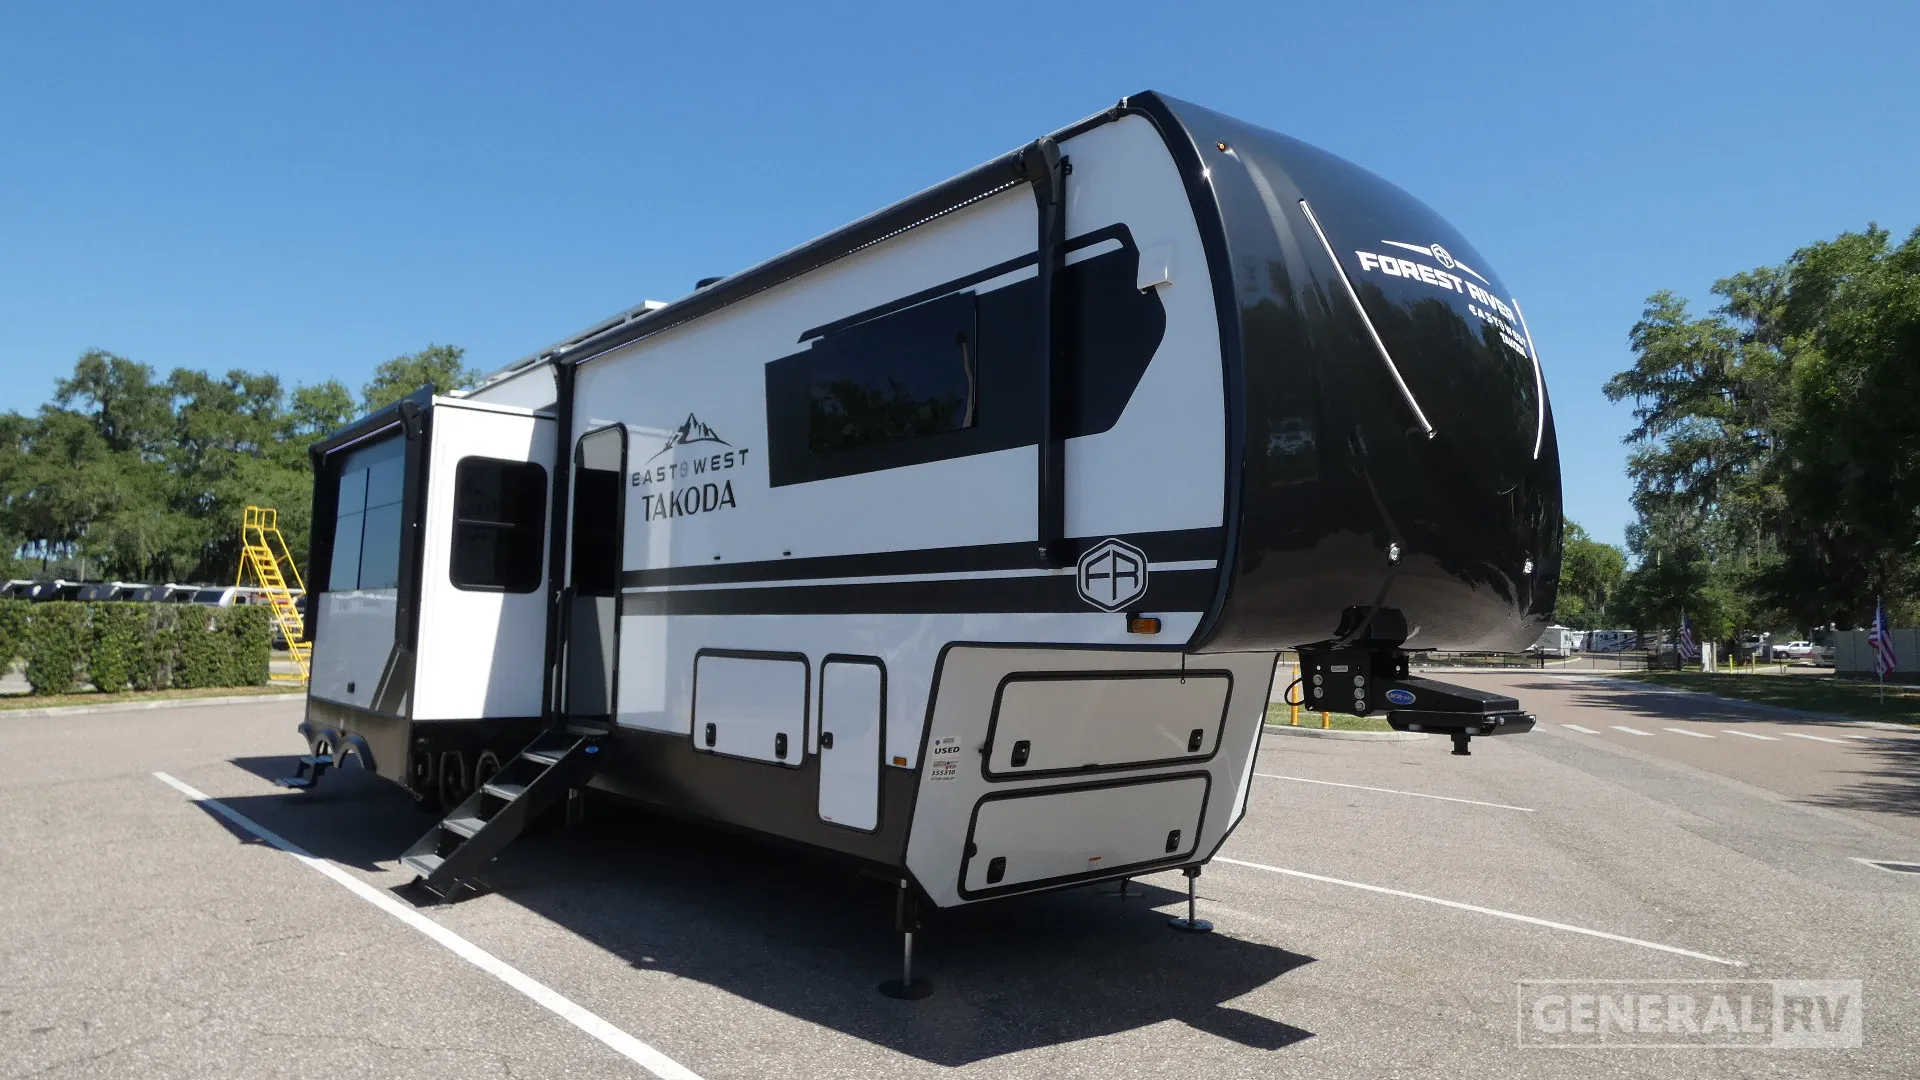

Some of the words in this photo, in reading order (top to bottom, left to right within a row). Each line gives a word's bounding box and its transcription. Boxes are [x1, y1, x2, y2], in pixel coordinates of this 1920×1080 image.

[1355, 250, 1463, 294] FOREST
[1464, 280, 1517, 325] RIVER
[1468, 303, 1499, 327] EAST
[632, 463, 678, 487] EAST
[693, 448, 749, 475] WEST
[642, 479, 736, 522] TAKODA
[934, 746, 960, 754] USED
